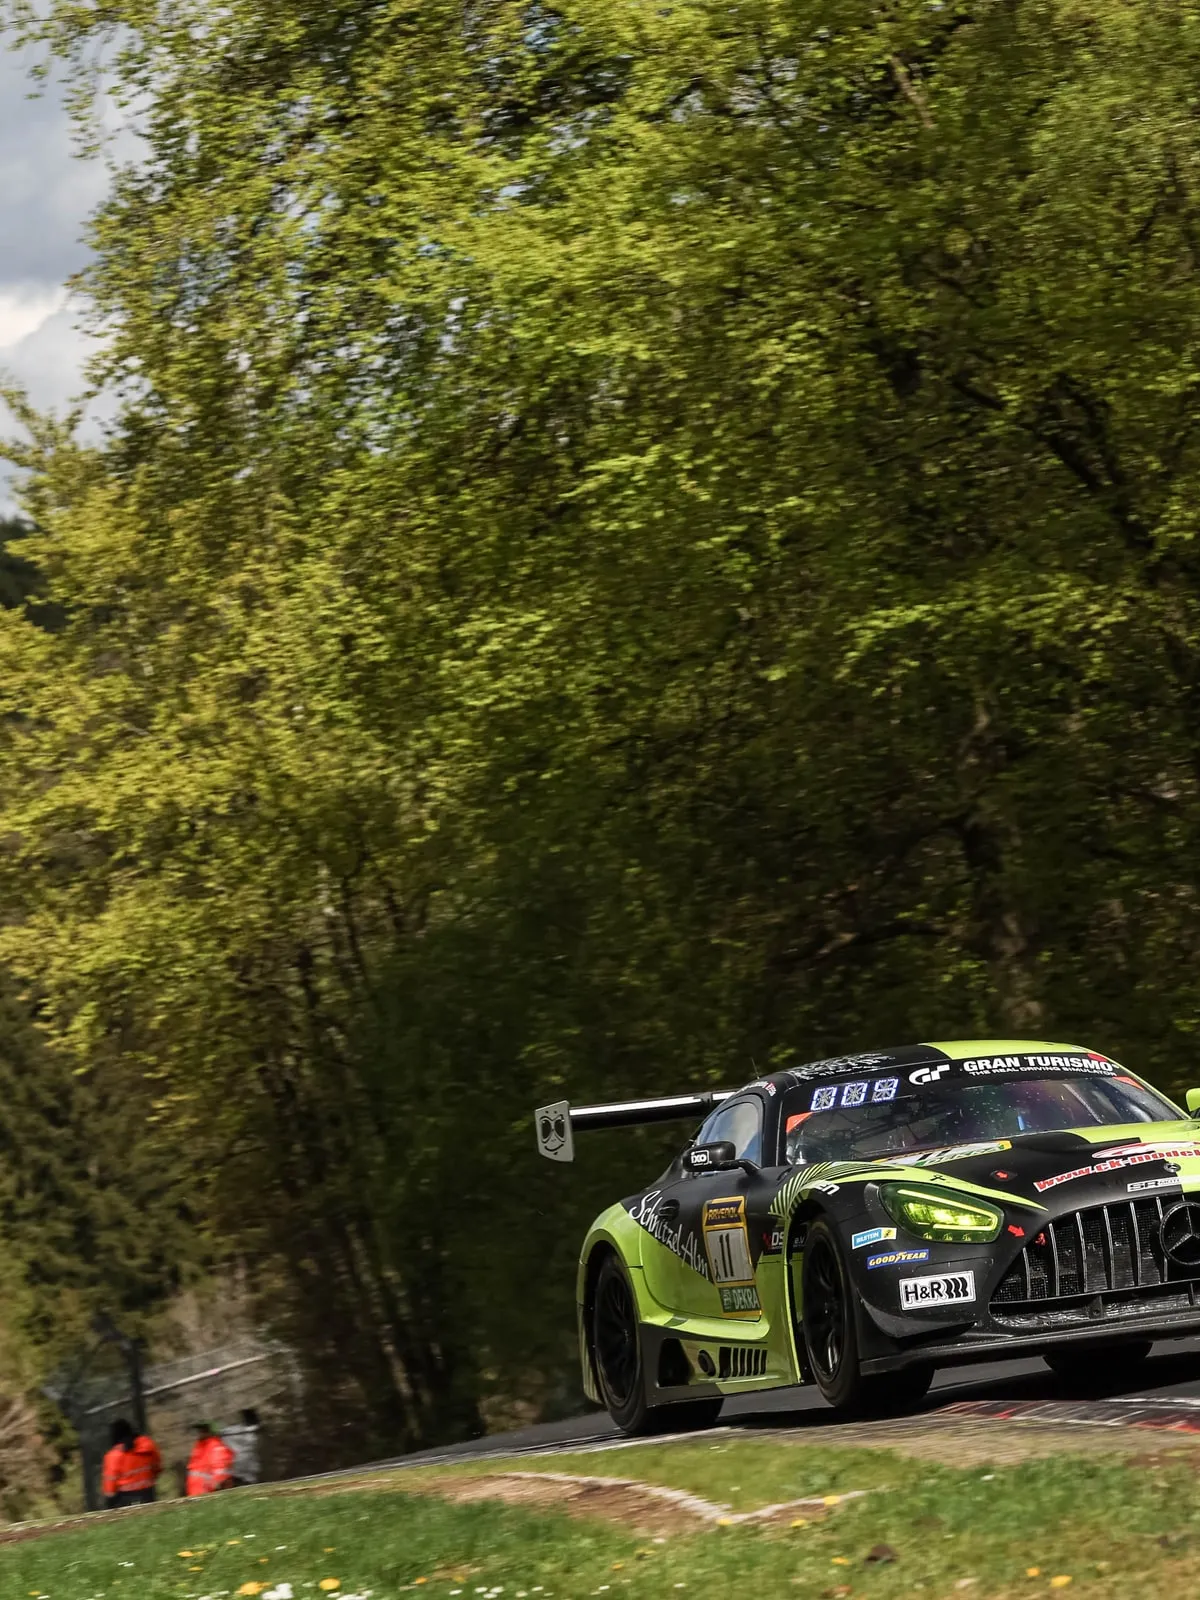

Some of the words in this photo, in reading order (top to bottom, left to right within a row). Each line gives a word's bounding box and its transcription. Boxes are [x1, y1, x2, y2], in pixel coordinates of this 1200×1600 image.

[963, 1056, 1020, 1072] GRAN
[1024, 1055, 1113, 1072] TURISMO
[969, 1069, 991, 1077] THE
[1061, 1066, 1117, 1077] SIMULATOR
[719, 1232, 735, 1278] 11
[868, 1251, 928, 1267] GOODYEAR
[732, 1287, 760, 1310] DEKRA
[904, 1281, 943, 1302] H&R
